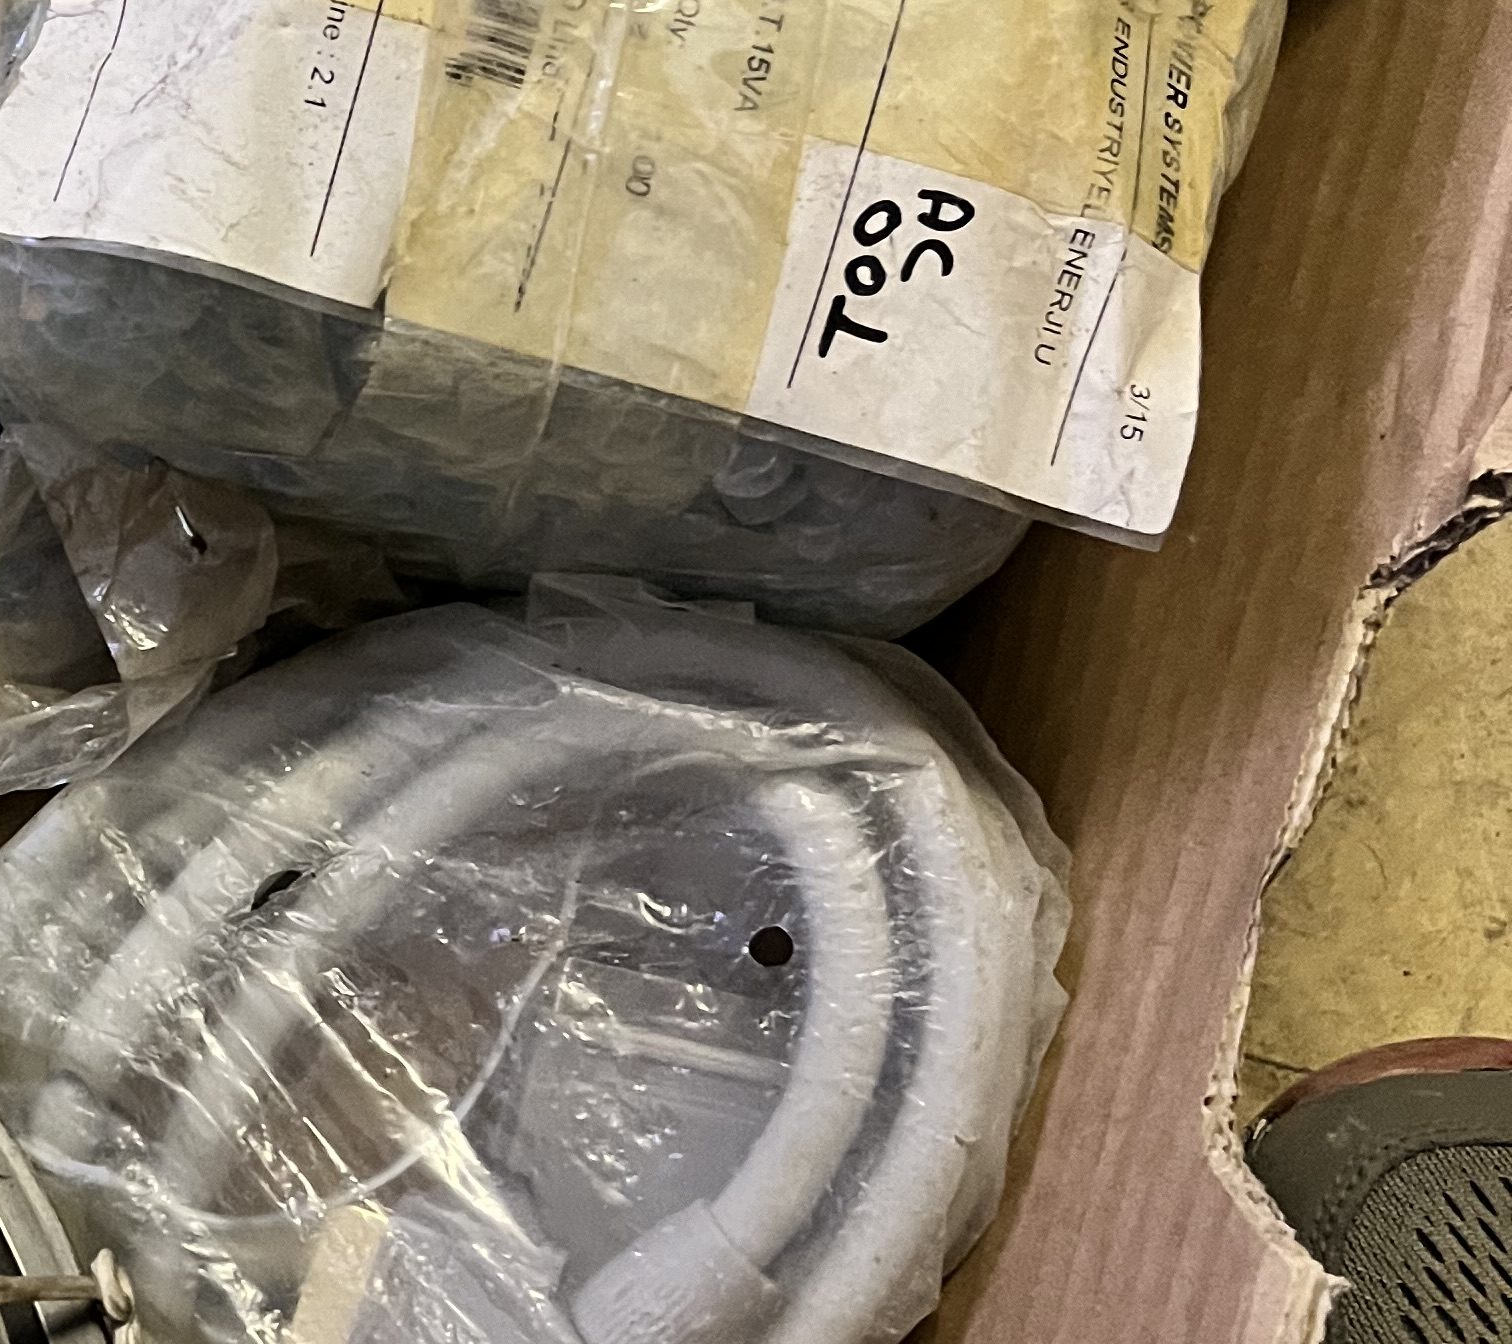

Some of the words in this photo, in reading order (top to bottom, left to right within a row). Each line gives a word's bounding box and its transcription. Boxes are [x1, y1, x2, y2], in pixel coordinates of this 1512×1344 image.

[303, 66, 335, 109] 2.1
[1150, 112, 1186, 252] SYSTEMS
[899, 188, 976, 293] AC
[1043, 228, 1096, 336] ENERJI
[1117, 383, 1154, 443] 3/15
